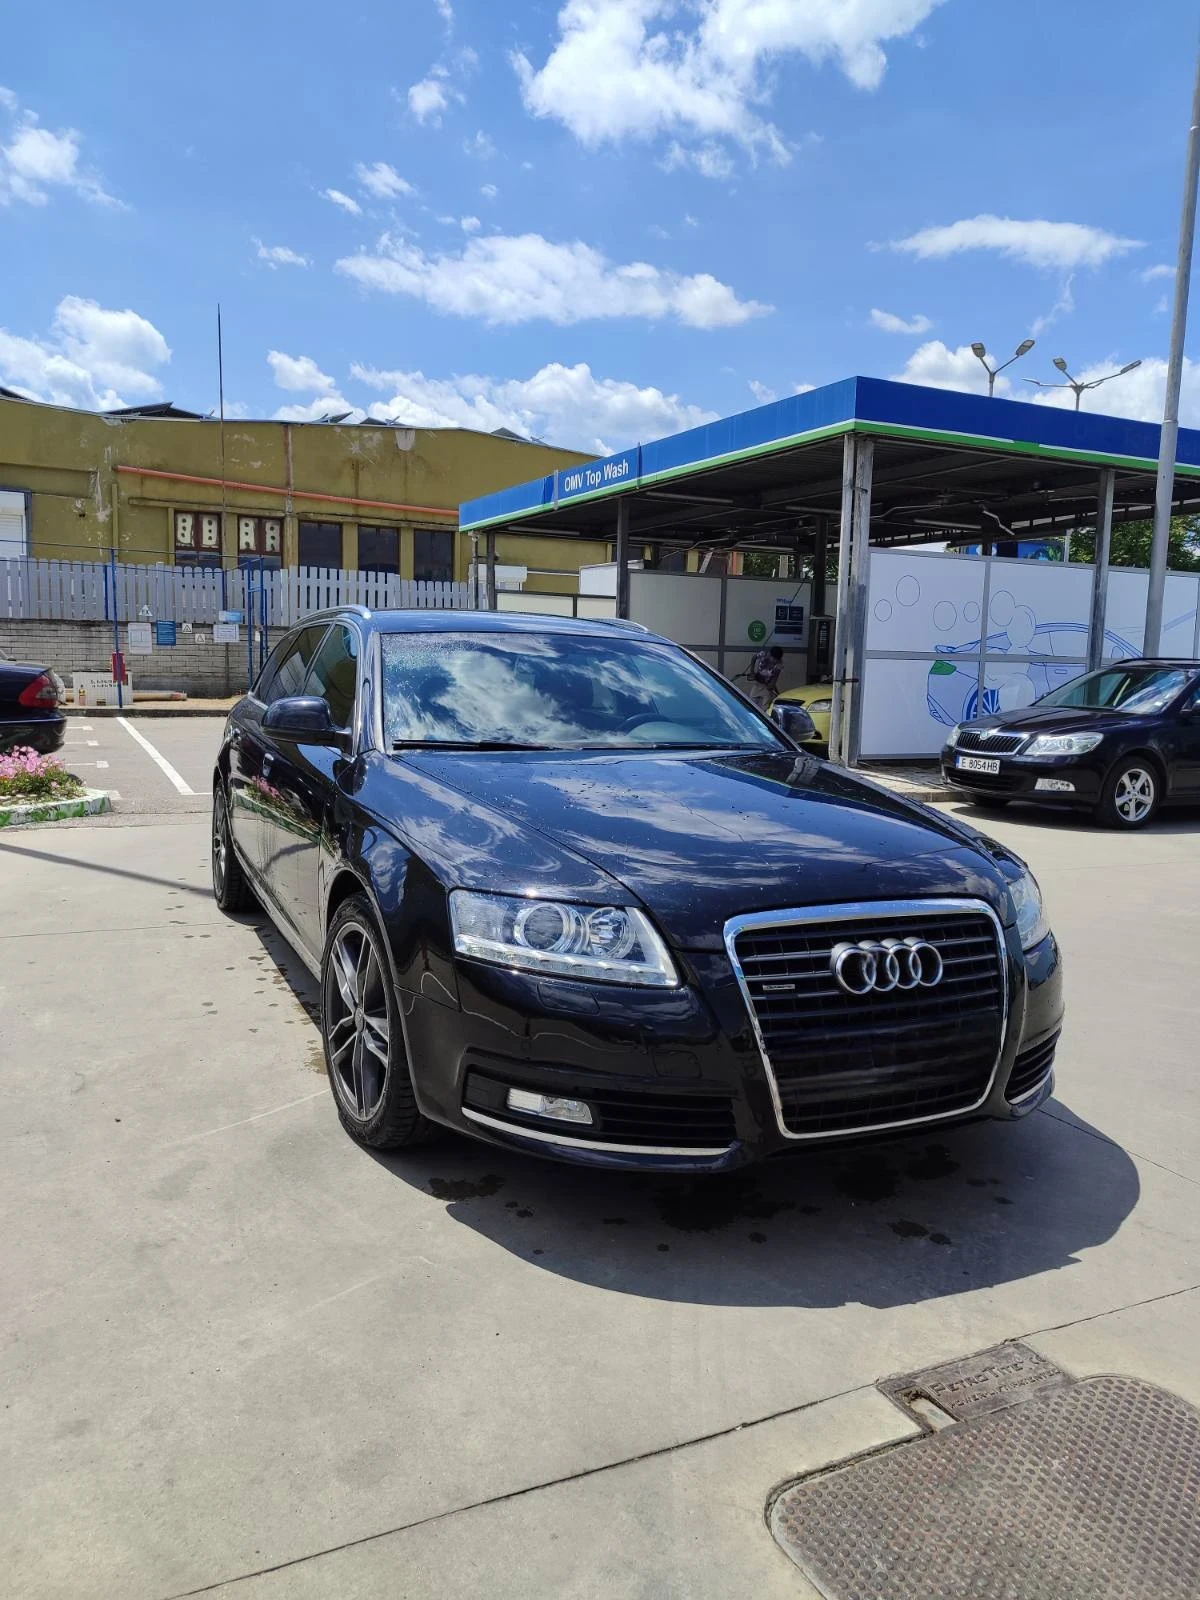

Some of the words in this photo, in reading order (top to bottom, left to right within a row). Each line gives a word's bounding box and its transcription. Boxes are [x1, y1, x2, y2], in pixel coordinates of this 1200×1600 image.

[564, 473, 584, 492] OMV
[585, 470, 602, 487] Top
[603, 458, 629, 480] Wash
